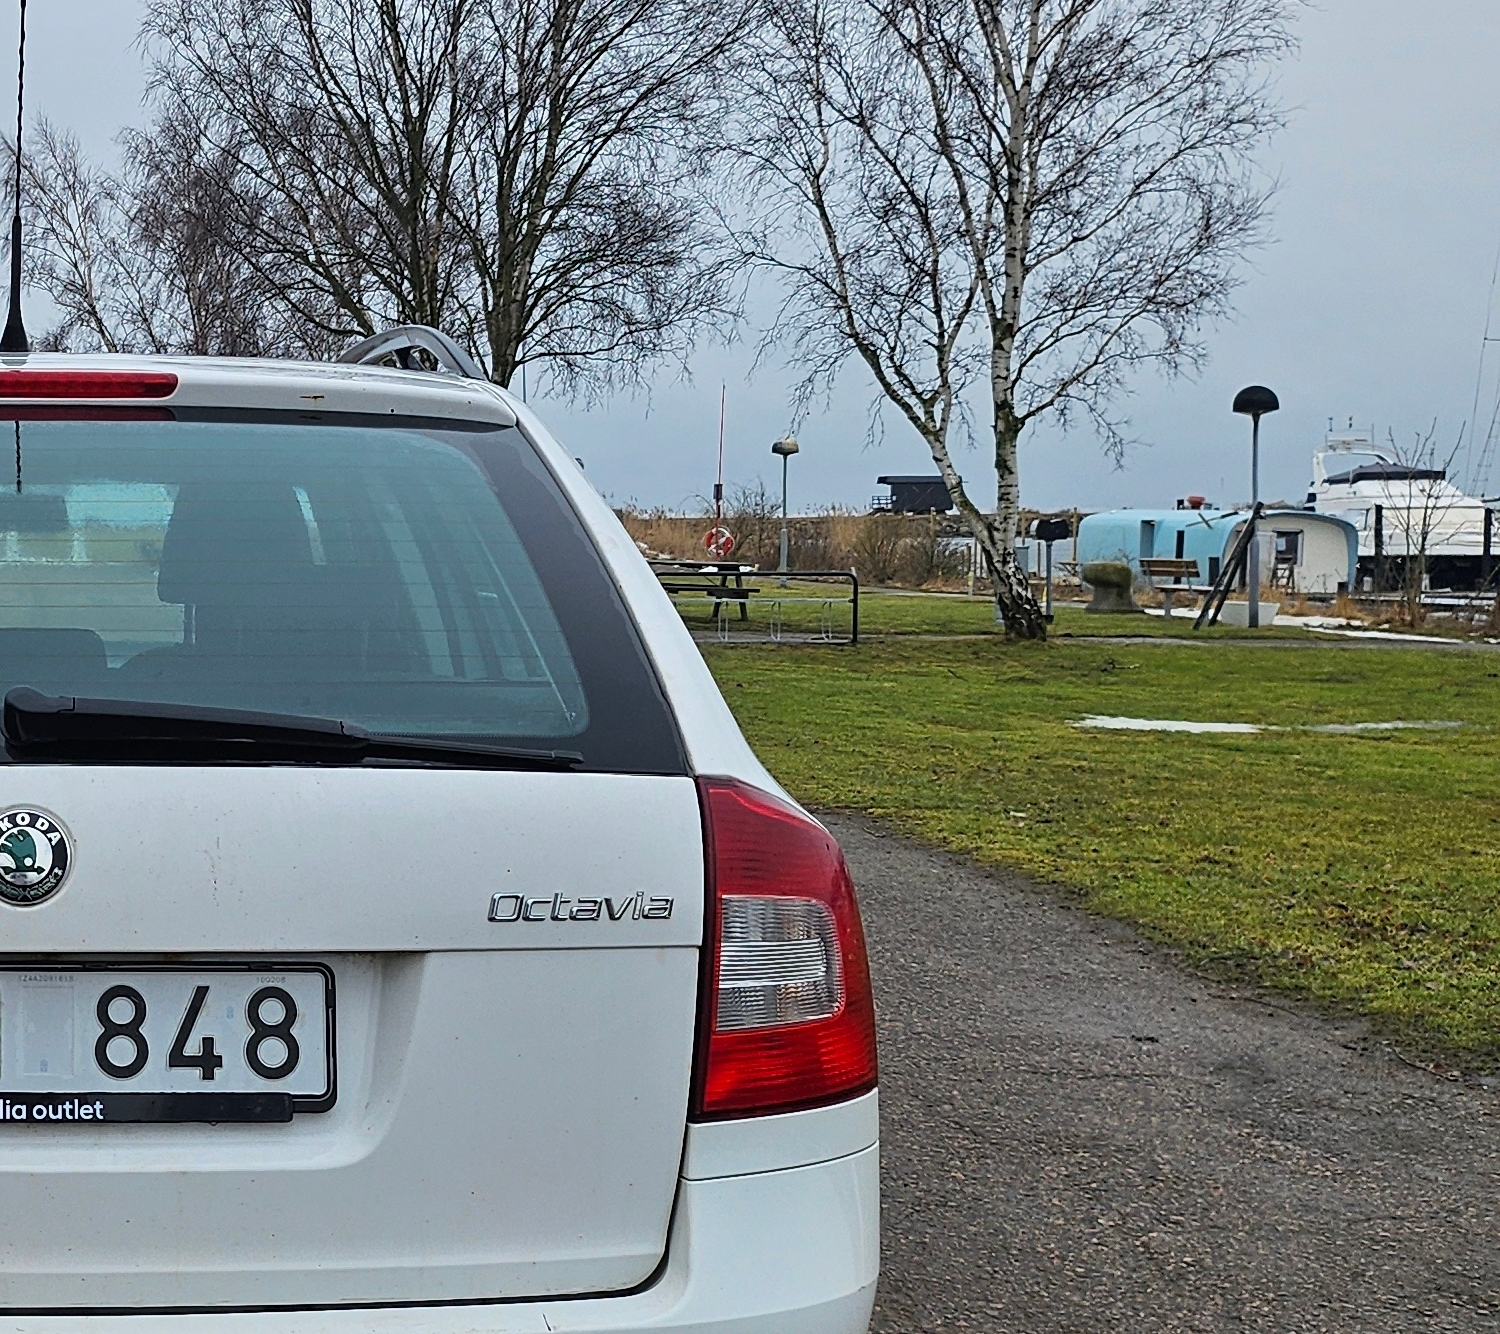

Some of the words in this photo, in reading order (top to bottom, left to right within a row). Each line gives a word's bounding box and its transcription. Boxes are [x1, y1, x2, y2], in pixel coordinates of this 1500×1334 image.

[487, 890, 675, 923] Octavia
[94, 984, 300, 1080] 848
[32, 1098, 104, 1120] outlet
